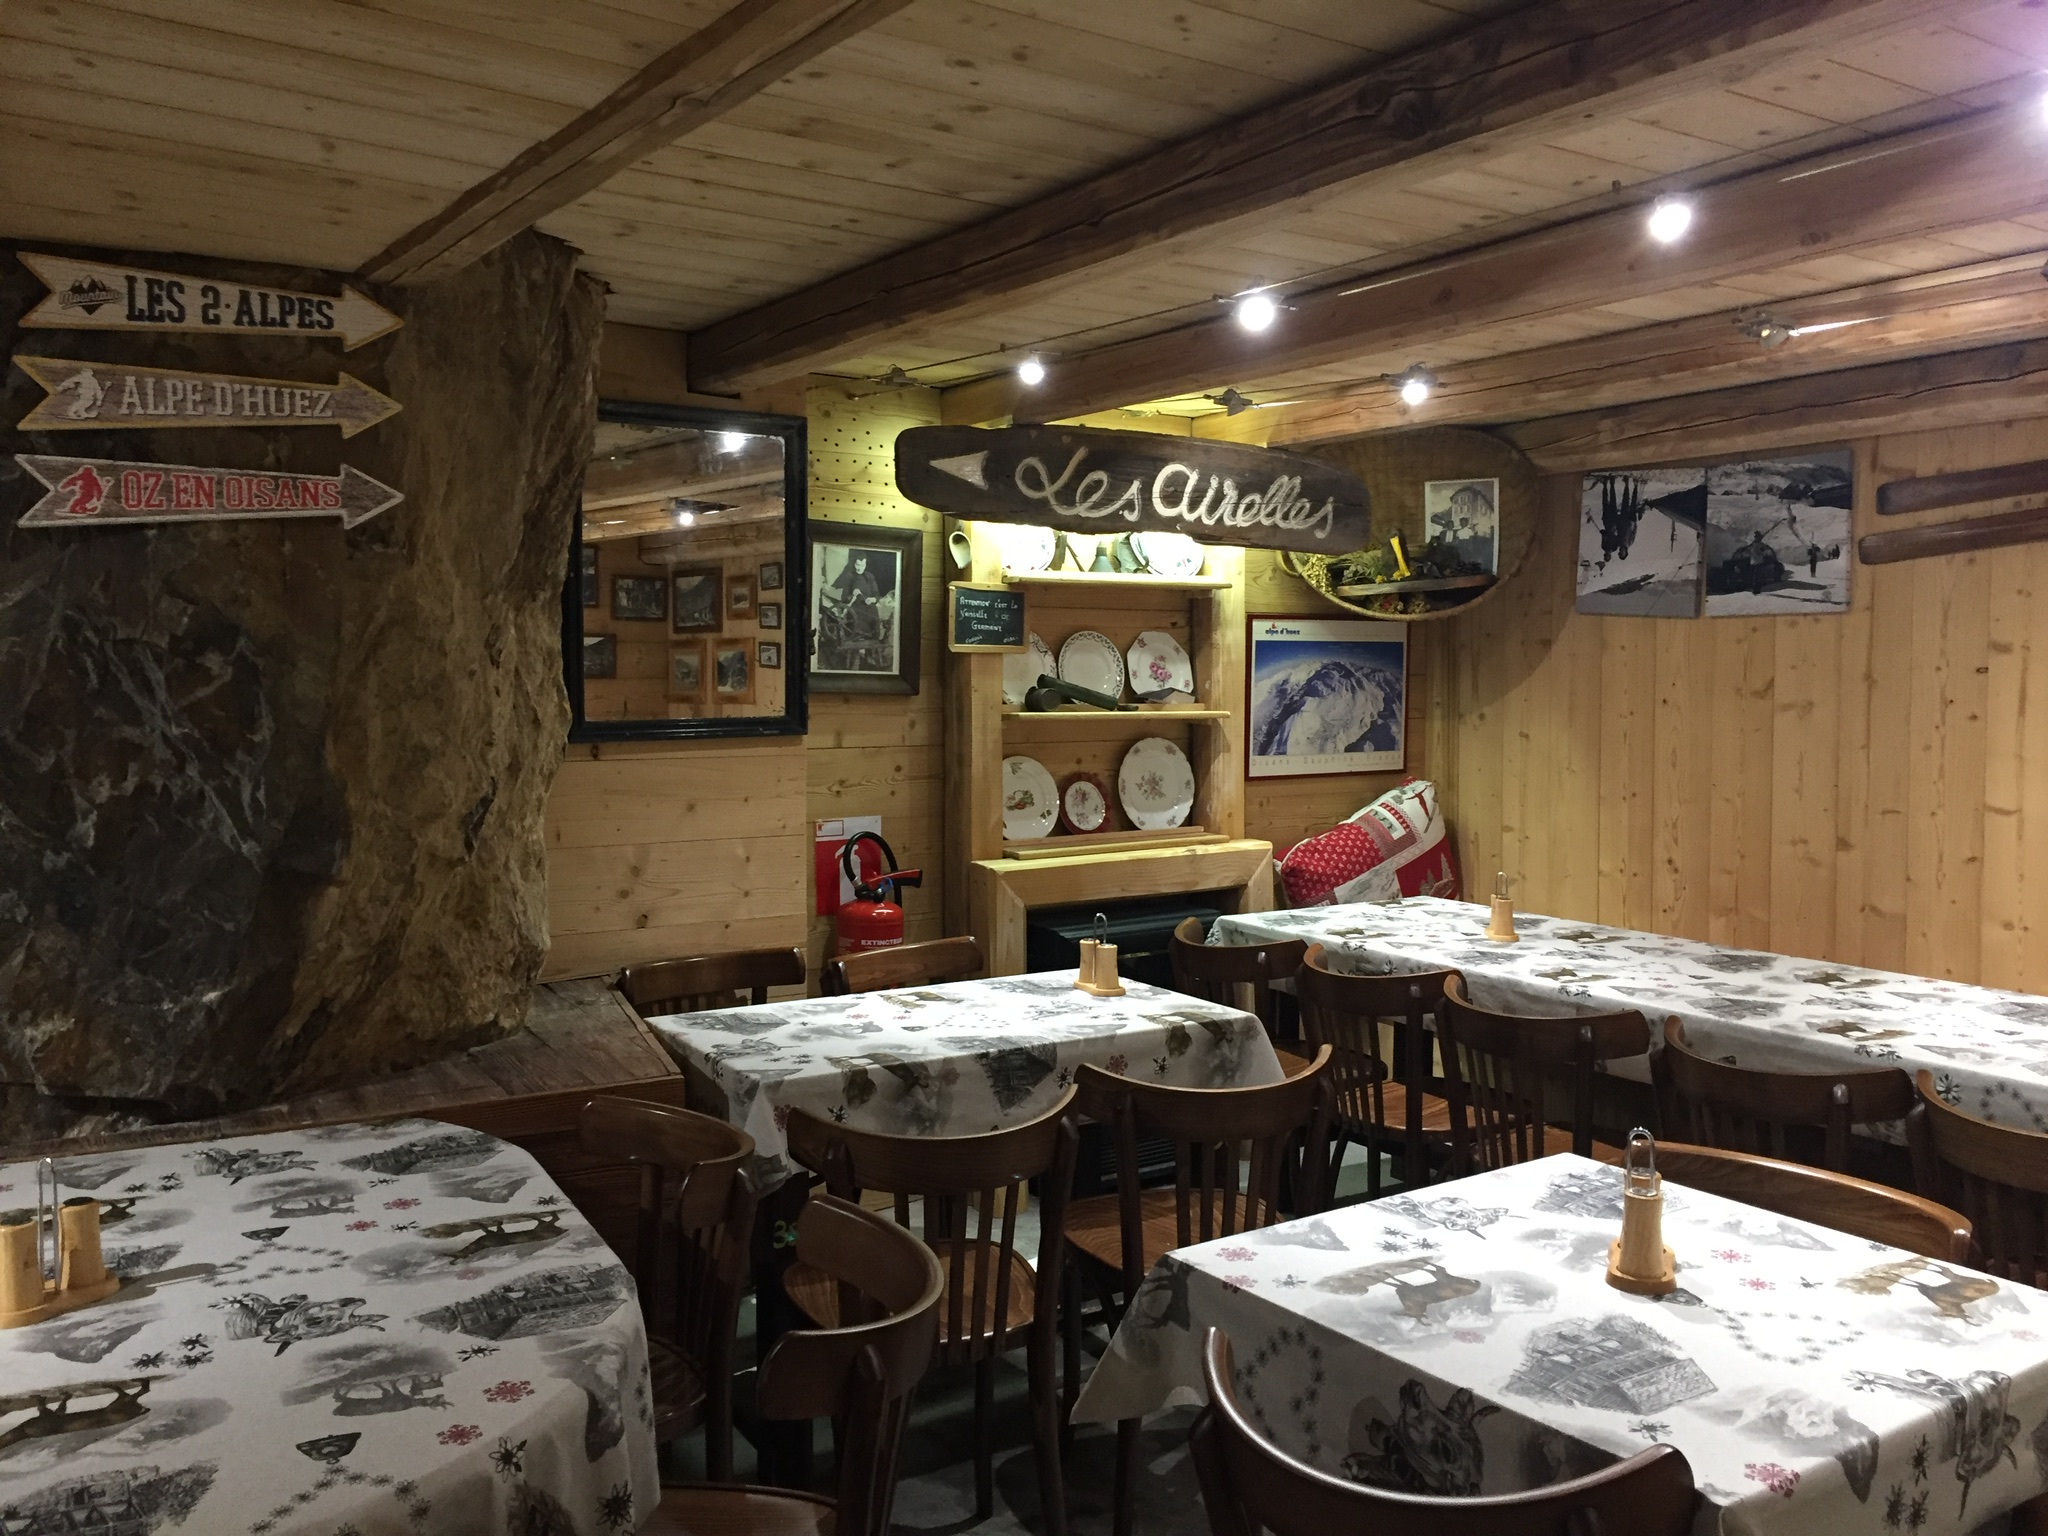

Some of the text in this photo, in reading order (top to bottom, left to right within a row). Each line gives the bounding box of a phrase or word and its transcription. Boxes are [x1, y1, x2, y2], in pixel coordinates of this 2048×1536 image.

[59, 287, 123, 305] Mountain
[125, 275, 186, 323] LES
[119, 376, 334, 418] ALPE D'HUEZ
[121, 470, 341, 510] OZ EN OISANS
[1015, 446, 1335, 539] Les Airelles
